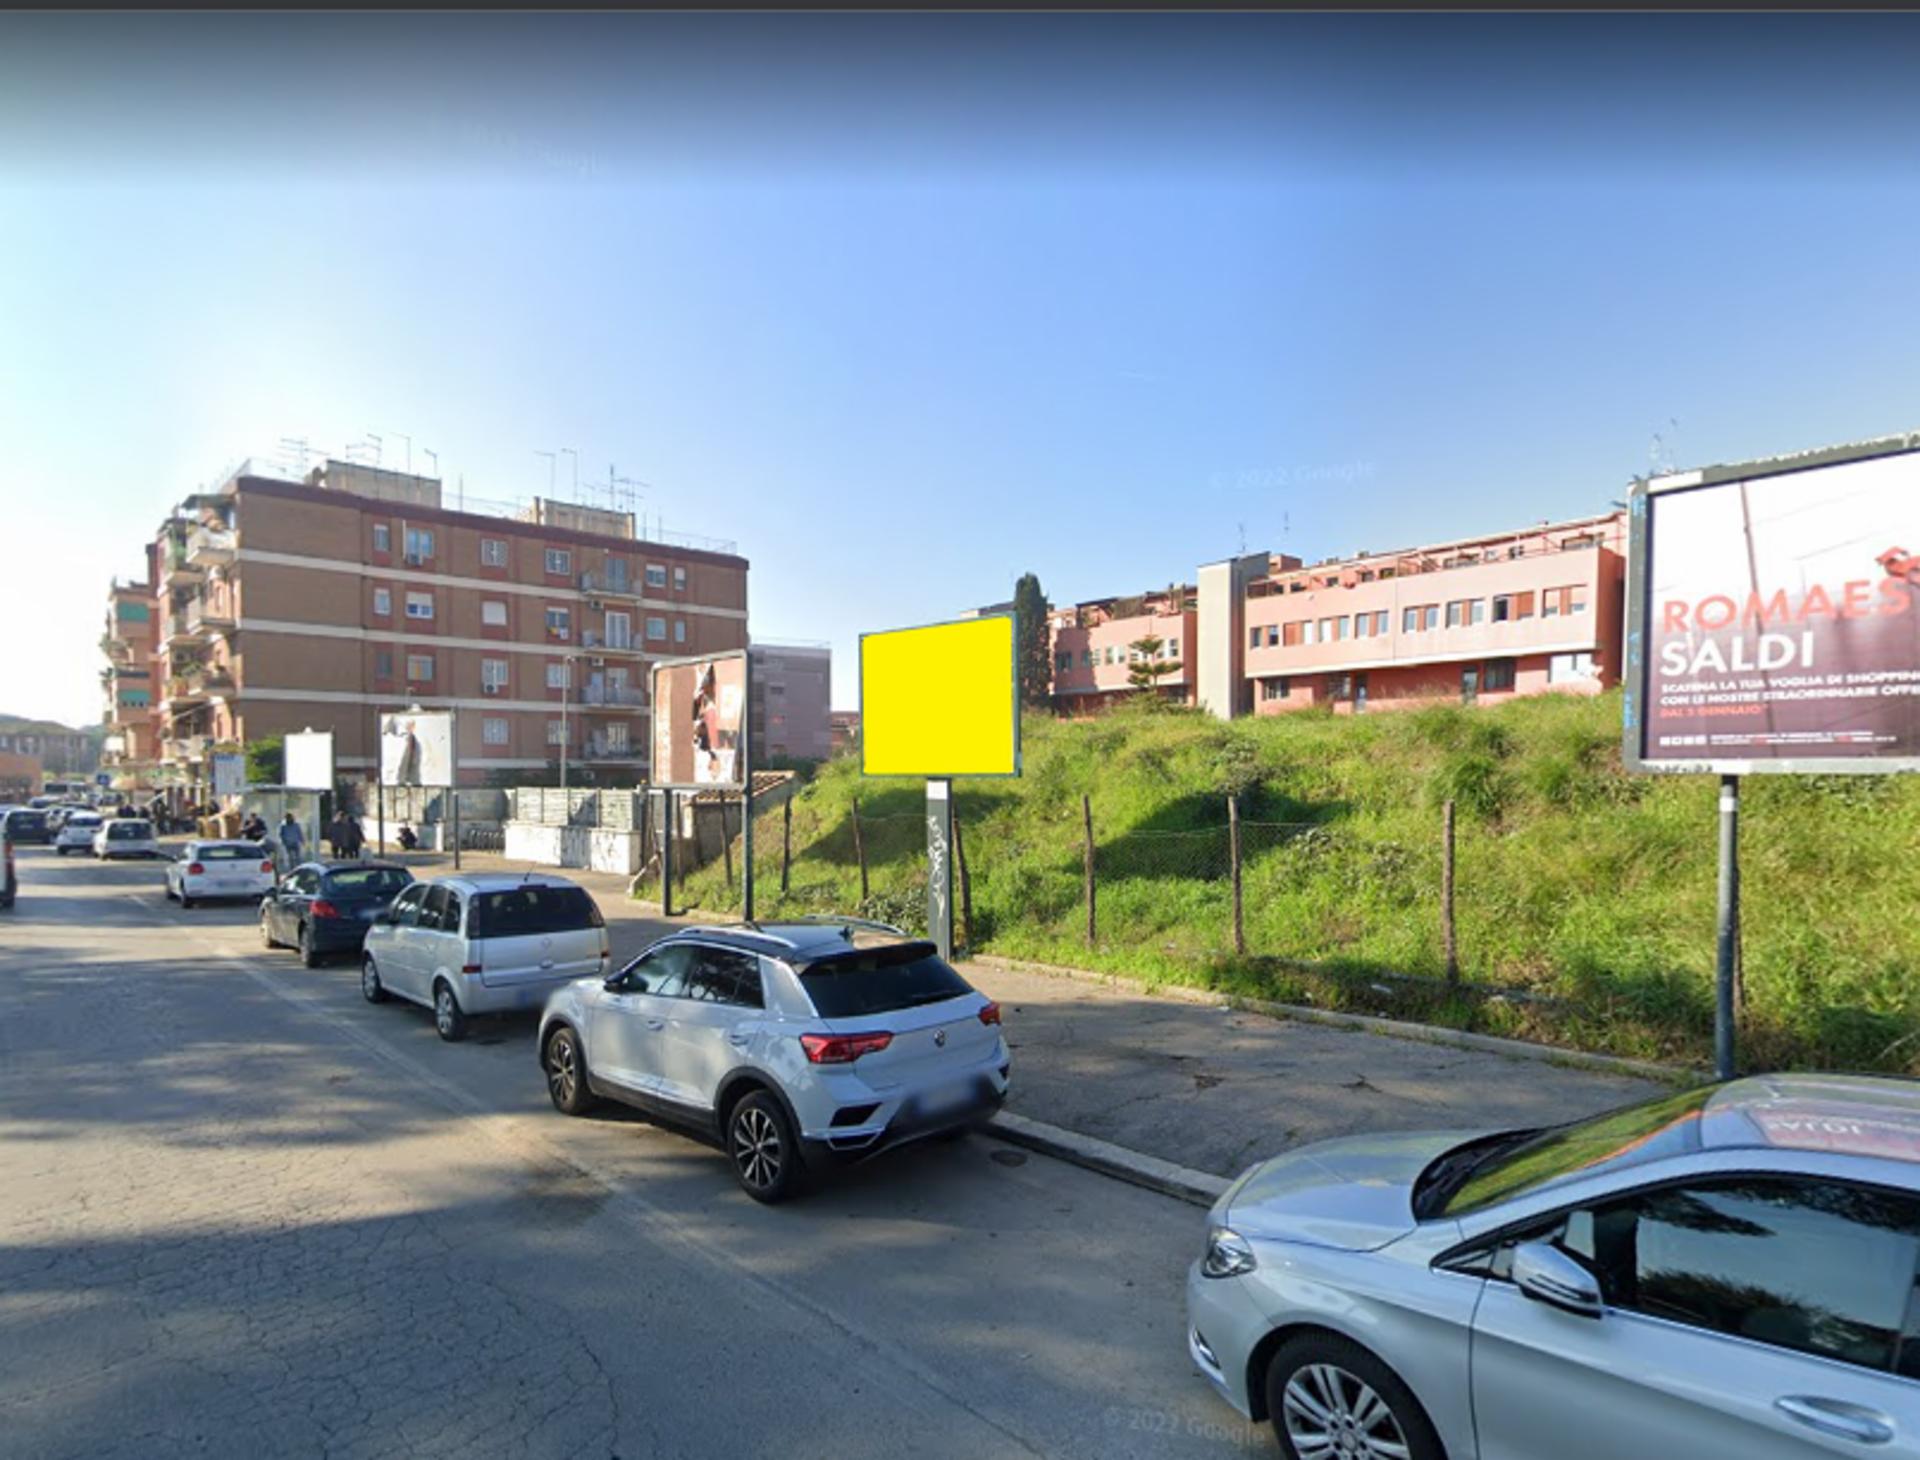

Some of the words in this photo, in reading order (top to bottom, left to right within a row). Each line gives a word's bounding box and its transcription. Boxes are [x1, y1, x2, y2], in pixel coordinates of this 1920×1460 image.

[1660, 631, 1814, 677] SALDI
[1720, 680, 1737, 691] LA
[1769, 675, 1824, 688] VOGLIA
